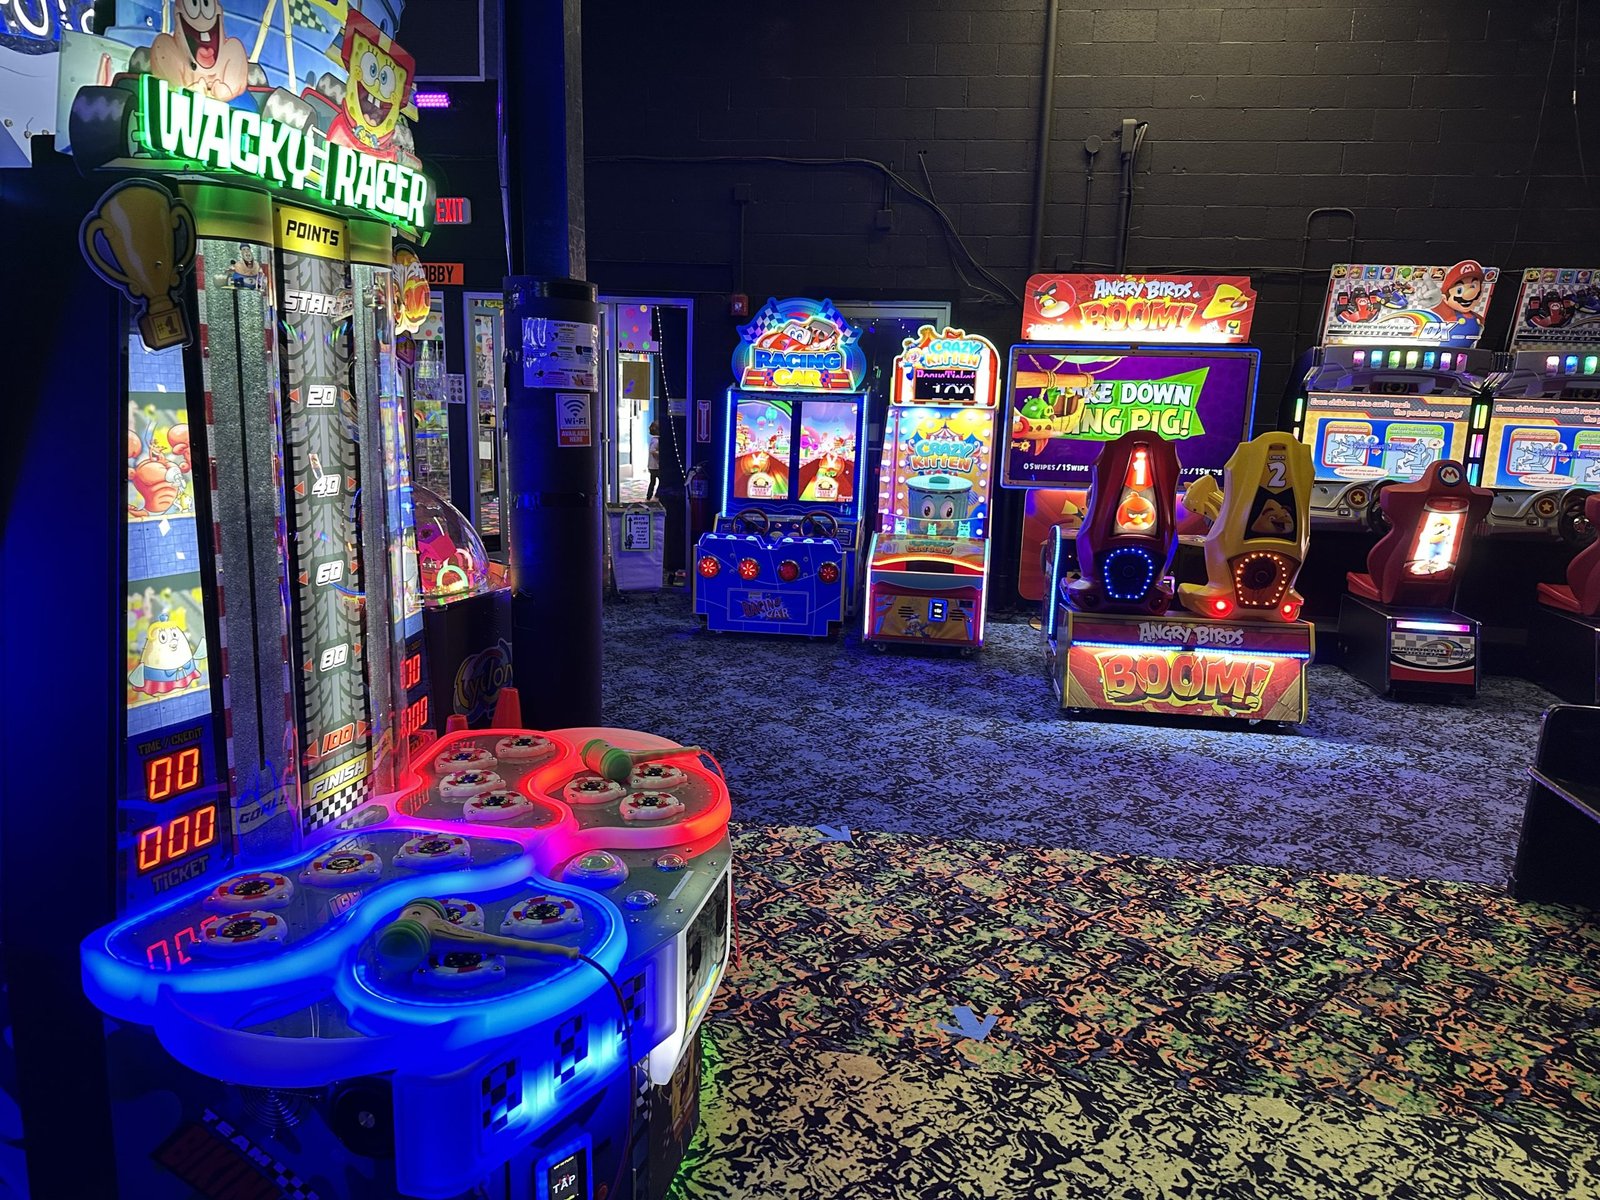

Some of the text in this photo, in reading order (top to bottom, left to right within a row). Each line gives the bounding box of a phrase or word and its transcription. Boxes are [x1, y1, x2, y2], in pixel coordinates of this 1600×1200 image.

[158, 79, 428, 227] WACKY RACER
[436, 198, 464, 222] EXIT
[286, 219, 340, 246] POINTS
[422, 265, 454, 283] OBBY
[1094, 279, 1194, 300] ANGRY BIRDS
[1081, 299, 1197, 332] BOOM!
[1420, 322, 1457, 341] DX
[928, 340, 982, 354] CRAZY
[755, 350, 841, 369] RACING
[924, 353, 982, 369] KITTEN
[773, 369, 823, 387] CAR
[307, 384, 337, 408] 20
[1121, 382, 1193, 407] DOWN
[1311, 398, 1328, 406] Even
[1329, 399, 1356, 408] children
[1357, 400, 1372, 408] who
[1495, 405, 1514, 413] Even
[1515, 405, 1544, 414] children
[1545, 406, 1560, 414] who
[561, 429, 589, 437] AVAILABLE
[1130, 407, 1192, 437] PIG!
[915, 441, 976, 457] CRAZY
[910, 454, 974, 472] KITTEN
[1132, 458, 1147, 486] 1
[1267, 461, 1287, 488] 2
[1441, 468, 1459, 481] M
[312, 473, 342, 498] 40
[315, 559, 345, 586] 60
[741, 594, 783, 618] RACING
[766, 608, 791, 620] CAR
[1139, 622, 1244, 645] ANGRY BIRDS
[320, 642, 349, 672] 80
[1103, 651, 1275, 713] BOOM!
[138, 739, 162, 755] TIME
[171, 727, 204, 745] CREDIT
[321, 722, 355, 756] 100
[149, 747, 200, 801] 00
[310, 757, 368, 799] FINISH
[138, 804, 216, 871] 000
[152, 855, 210, 893] TICKET
[202, 1107, 272, 1168] TEAM
[552, 1174, 576, 1194] TAP
